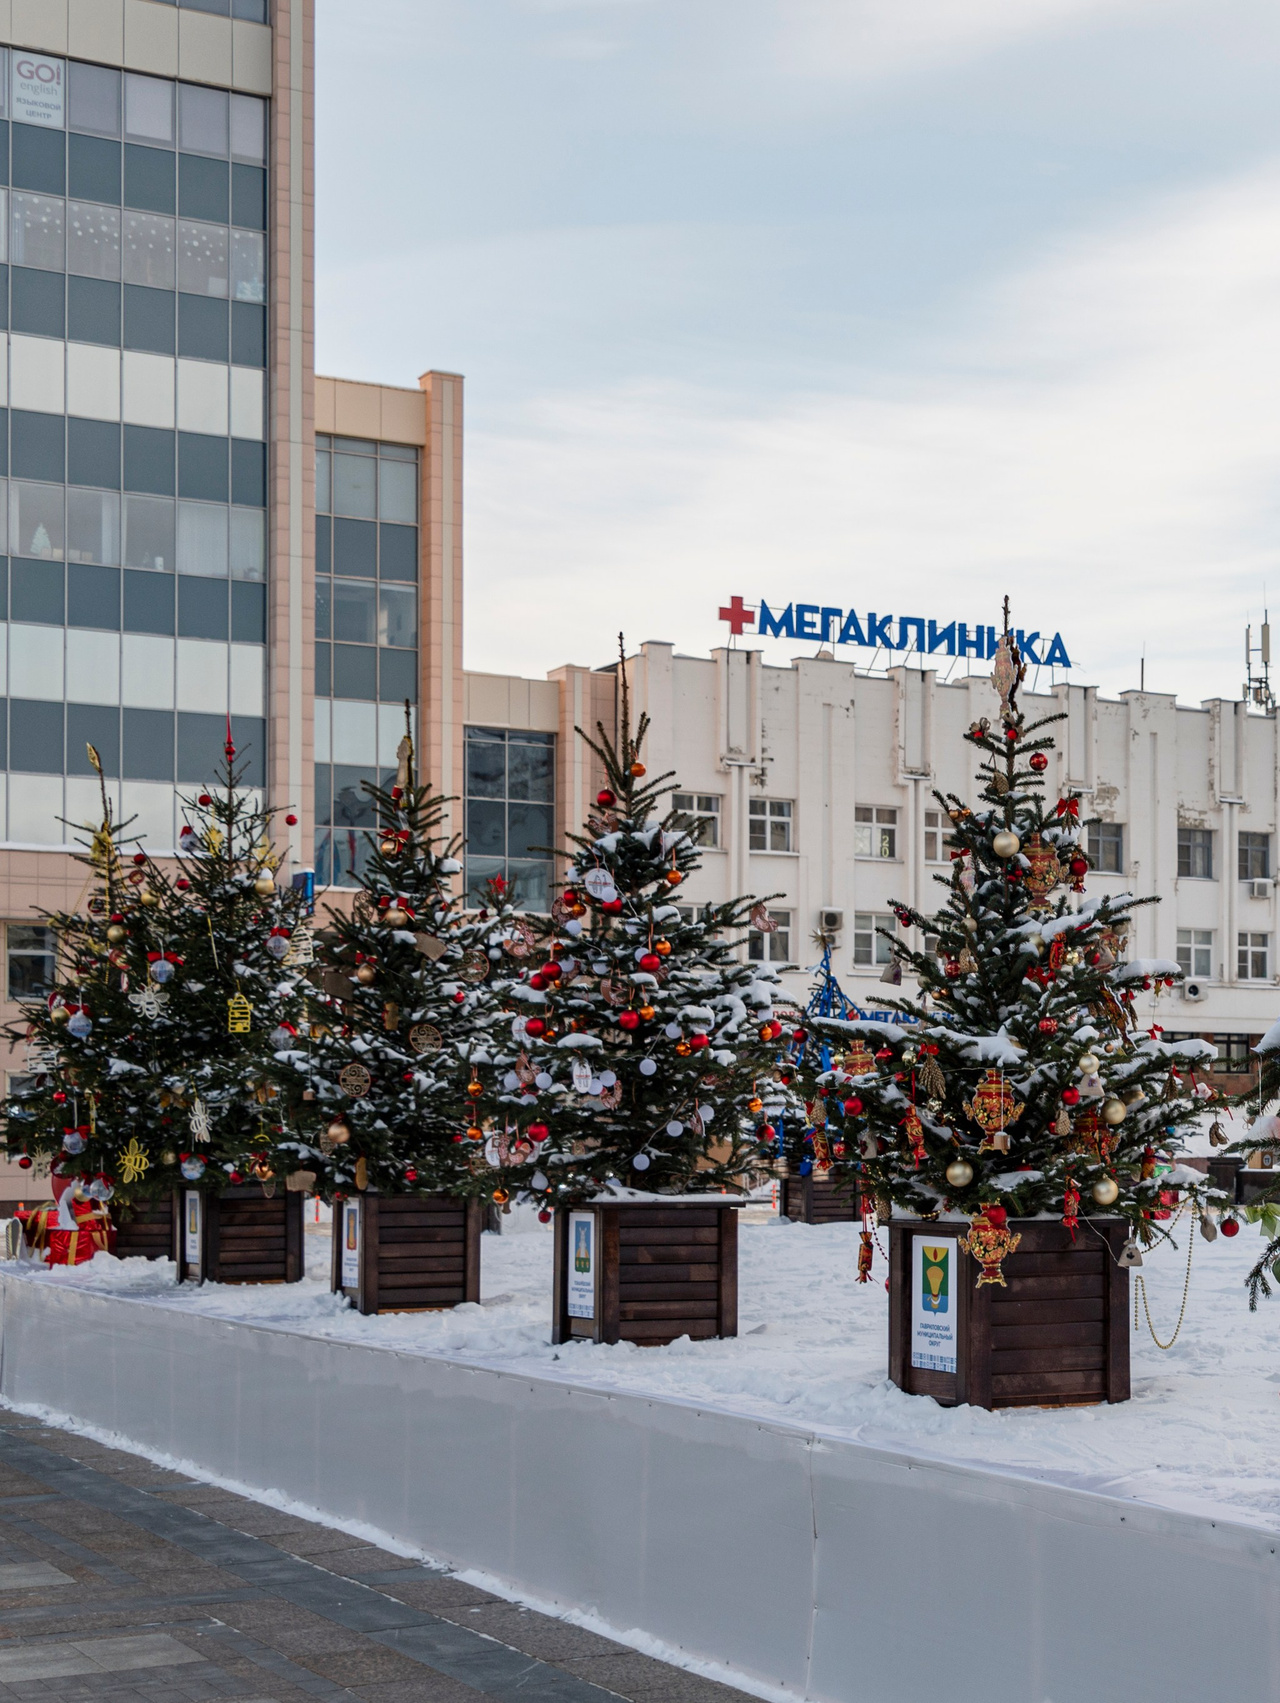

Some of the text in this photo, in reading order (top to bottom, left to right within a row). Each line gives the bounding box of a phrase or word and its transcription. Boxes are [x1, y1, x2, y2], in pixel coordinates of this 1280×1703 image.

[16, 60, 61, 86] GO!
[20, 82, 58, 96] english
[16, 97, 61, 111] ЯЗЫКОВОЙ
[25, 109, 52, 119] ЦЕНТР
[758, 598, 1072, 668] МЕГАКЛИНИКА
